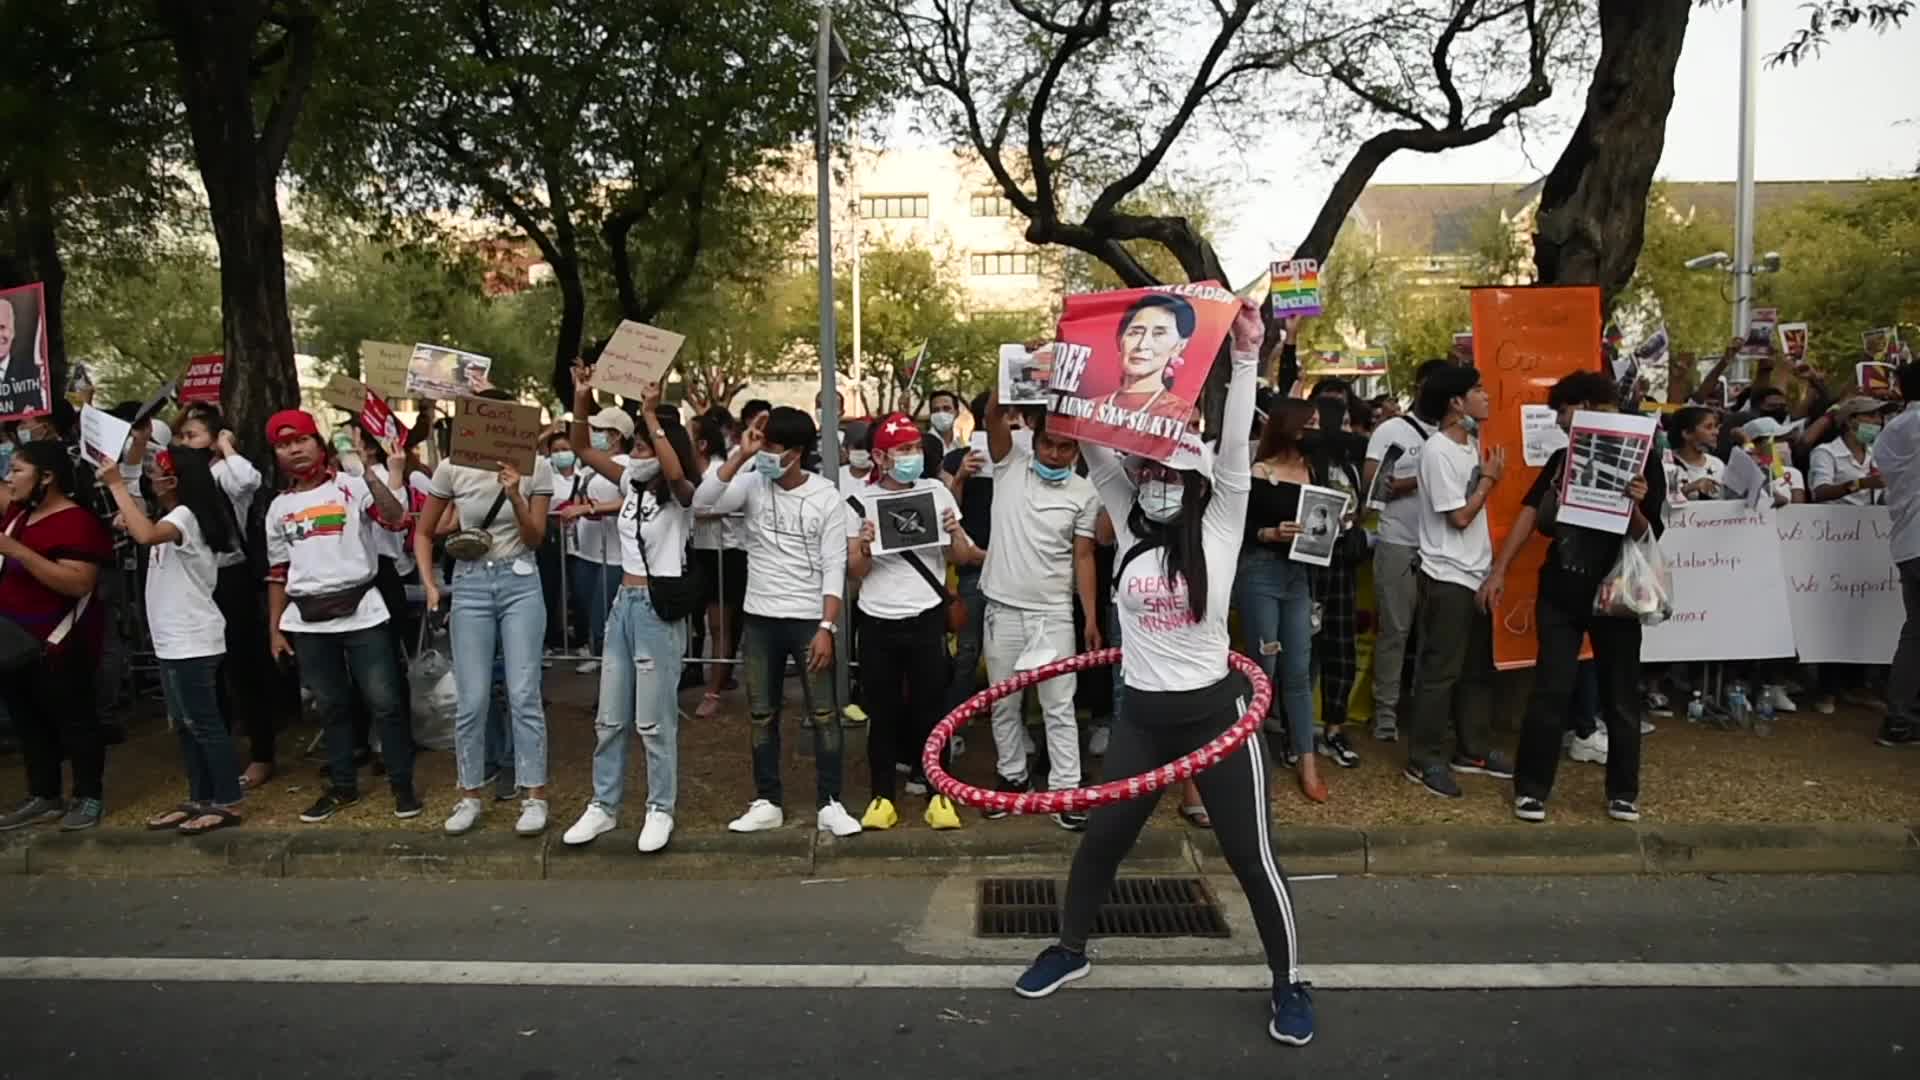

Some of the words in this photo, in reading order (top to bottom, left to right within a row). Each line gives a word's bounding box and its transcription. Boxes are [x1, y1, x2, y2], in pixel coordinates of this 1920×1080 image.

[1271, 258, 1318, 278] LGBTQ
[1174, 283, 1234, 304] LEADER
[1049, 342, 1092, 392] REE
[11, 379, 40, 395] WITH
[1777, 519, 1803, 541] We
[1810, 519, 1862, 542] Stand
[1790, 574, 1819, 592] We
[1829, 566, 1897, 600] Support
[1143, 594, 1185, 613] SAVE
